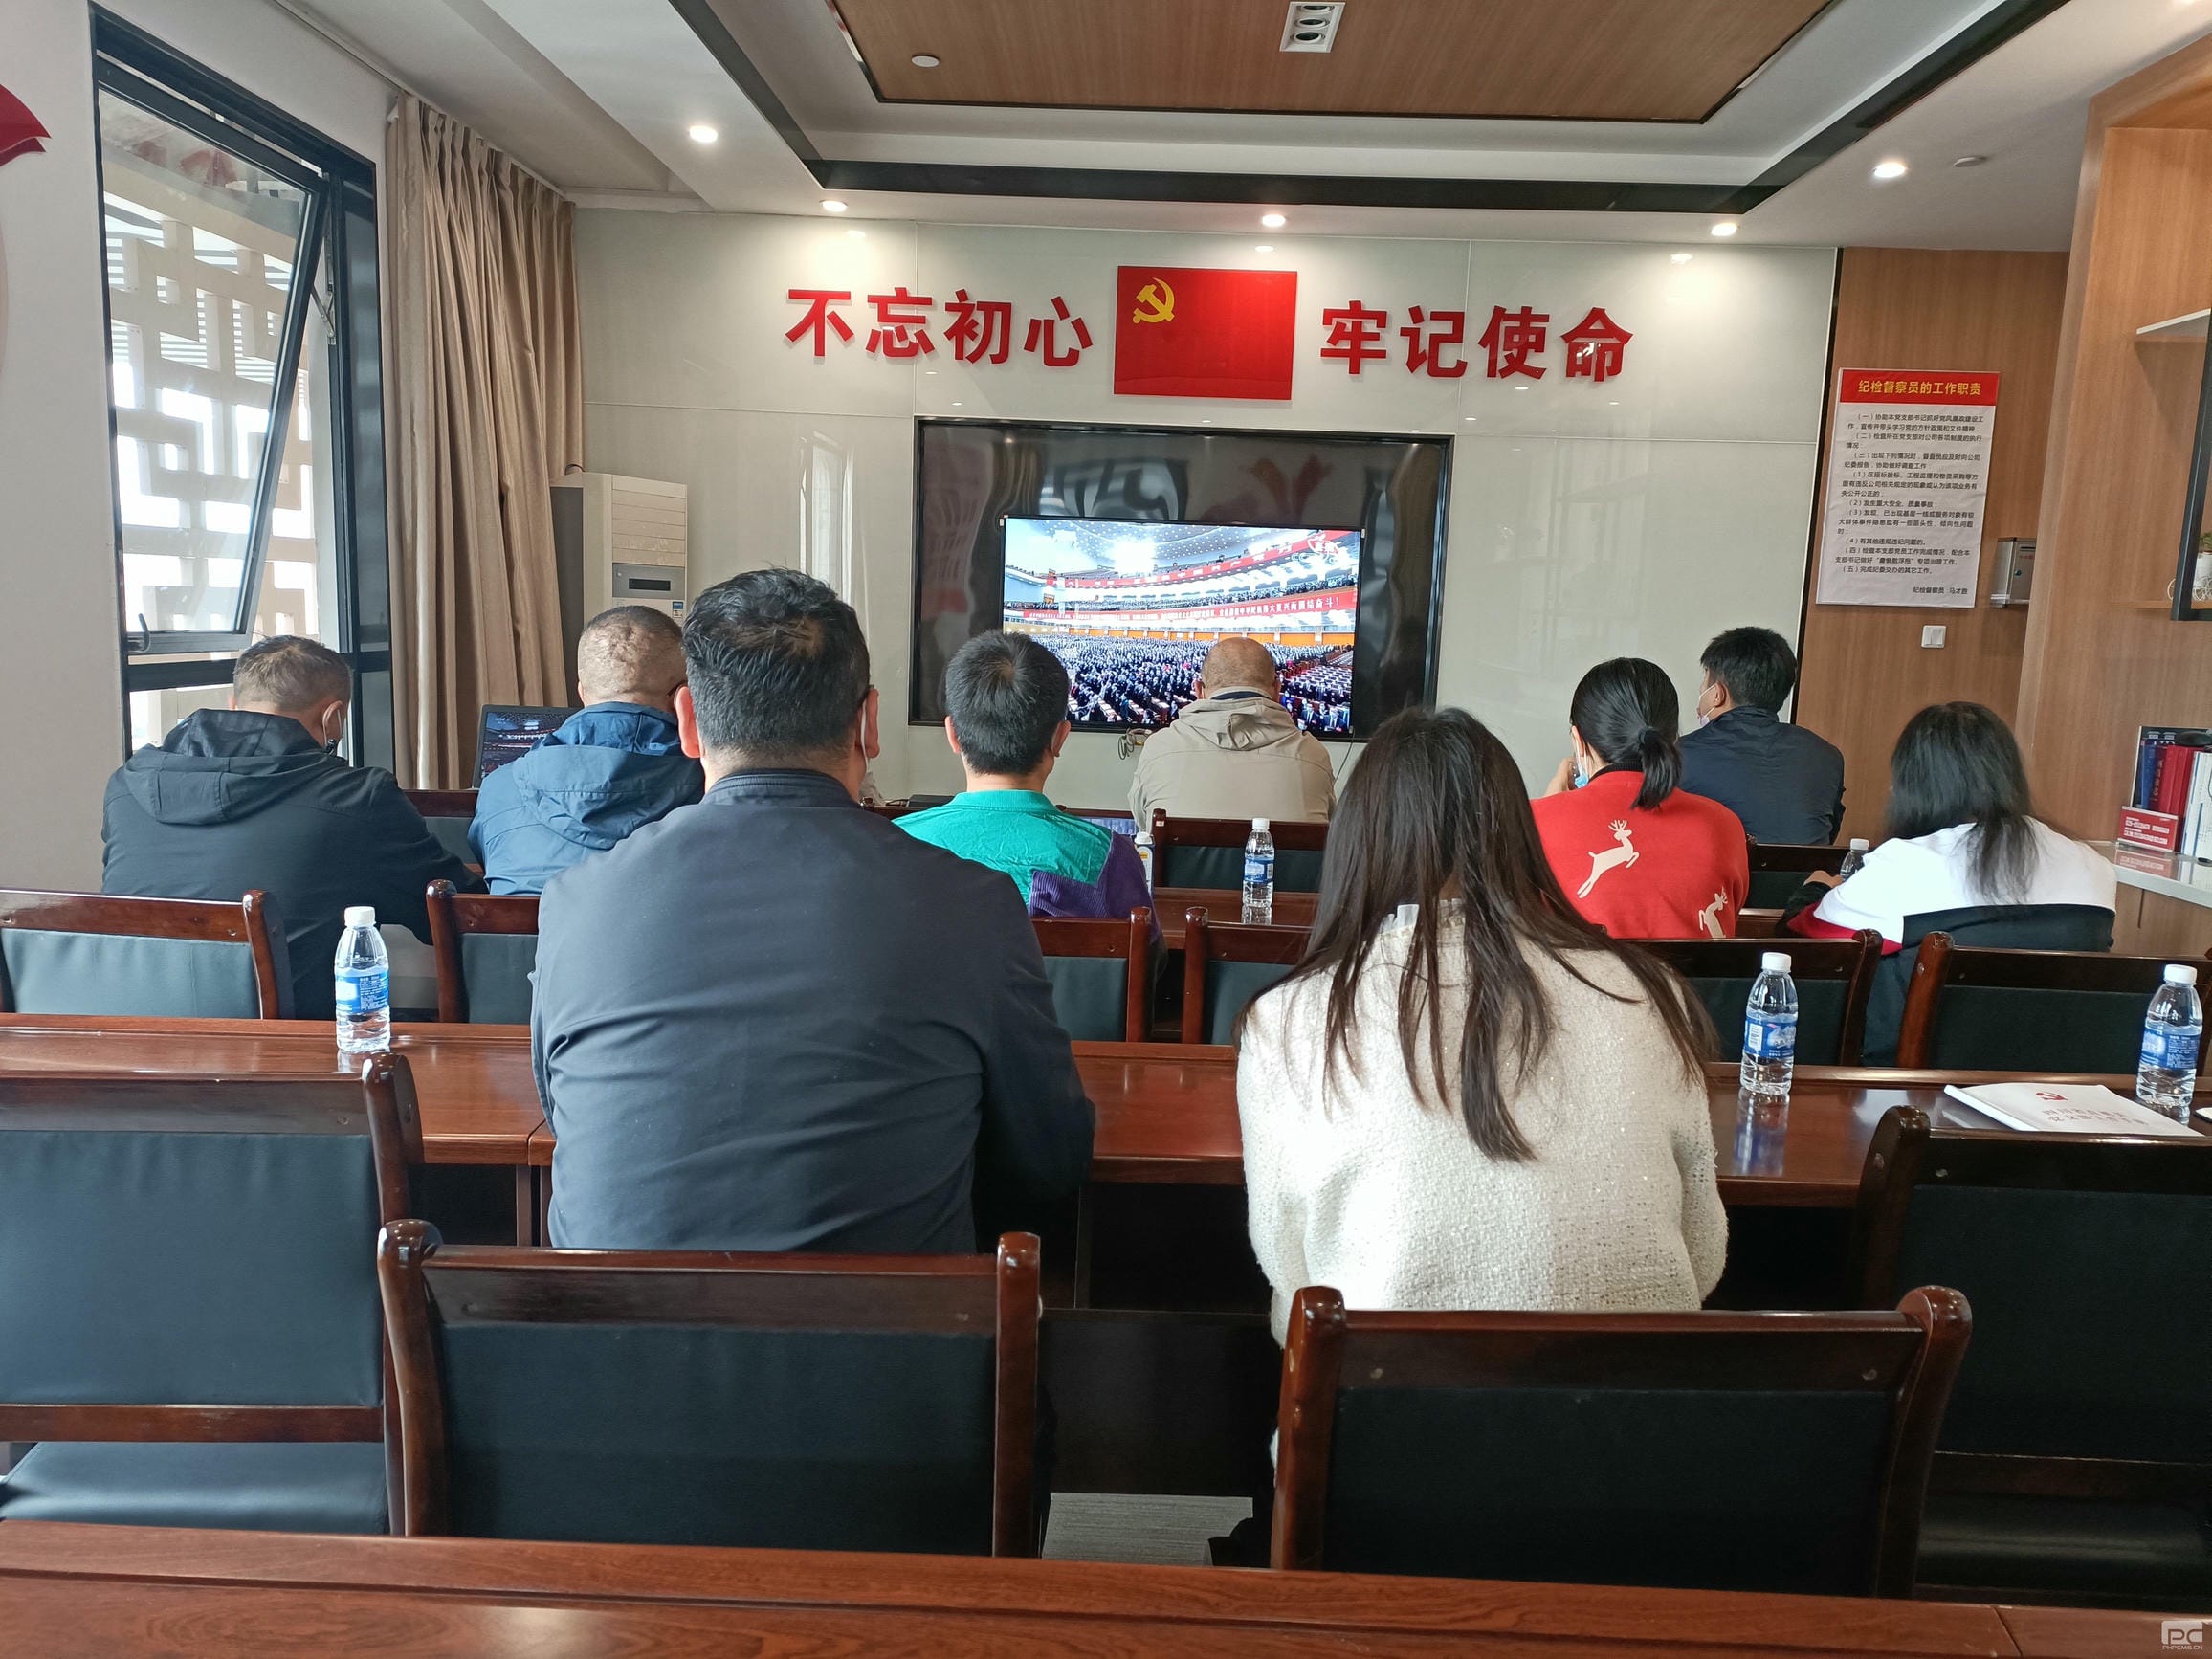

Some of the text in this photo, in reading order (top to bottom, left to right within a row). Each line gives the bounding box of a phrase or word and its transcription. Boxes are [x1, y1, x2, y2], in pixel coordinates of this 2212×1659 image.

[785, 288, 1093, 368] 不忘初心
[1320, 300, 1633, 383] 牢记使命
[1857, 379, 1981, 396] 纪检督察员的工作职责
